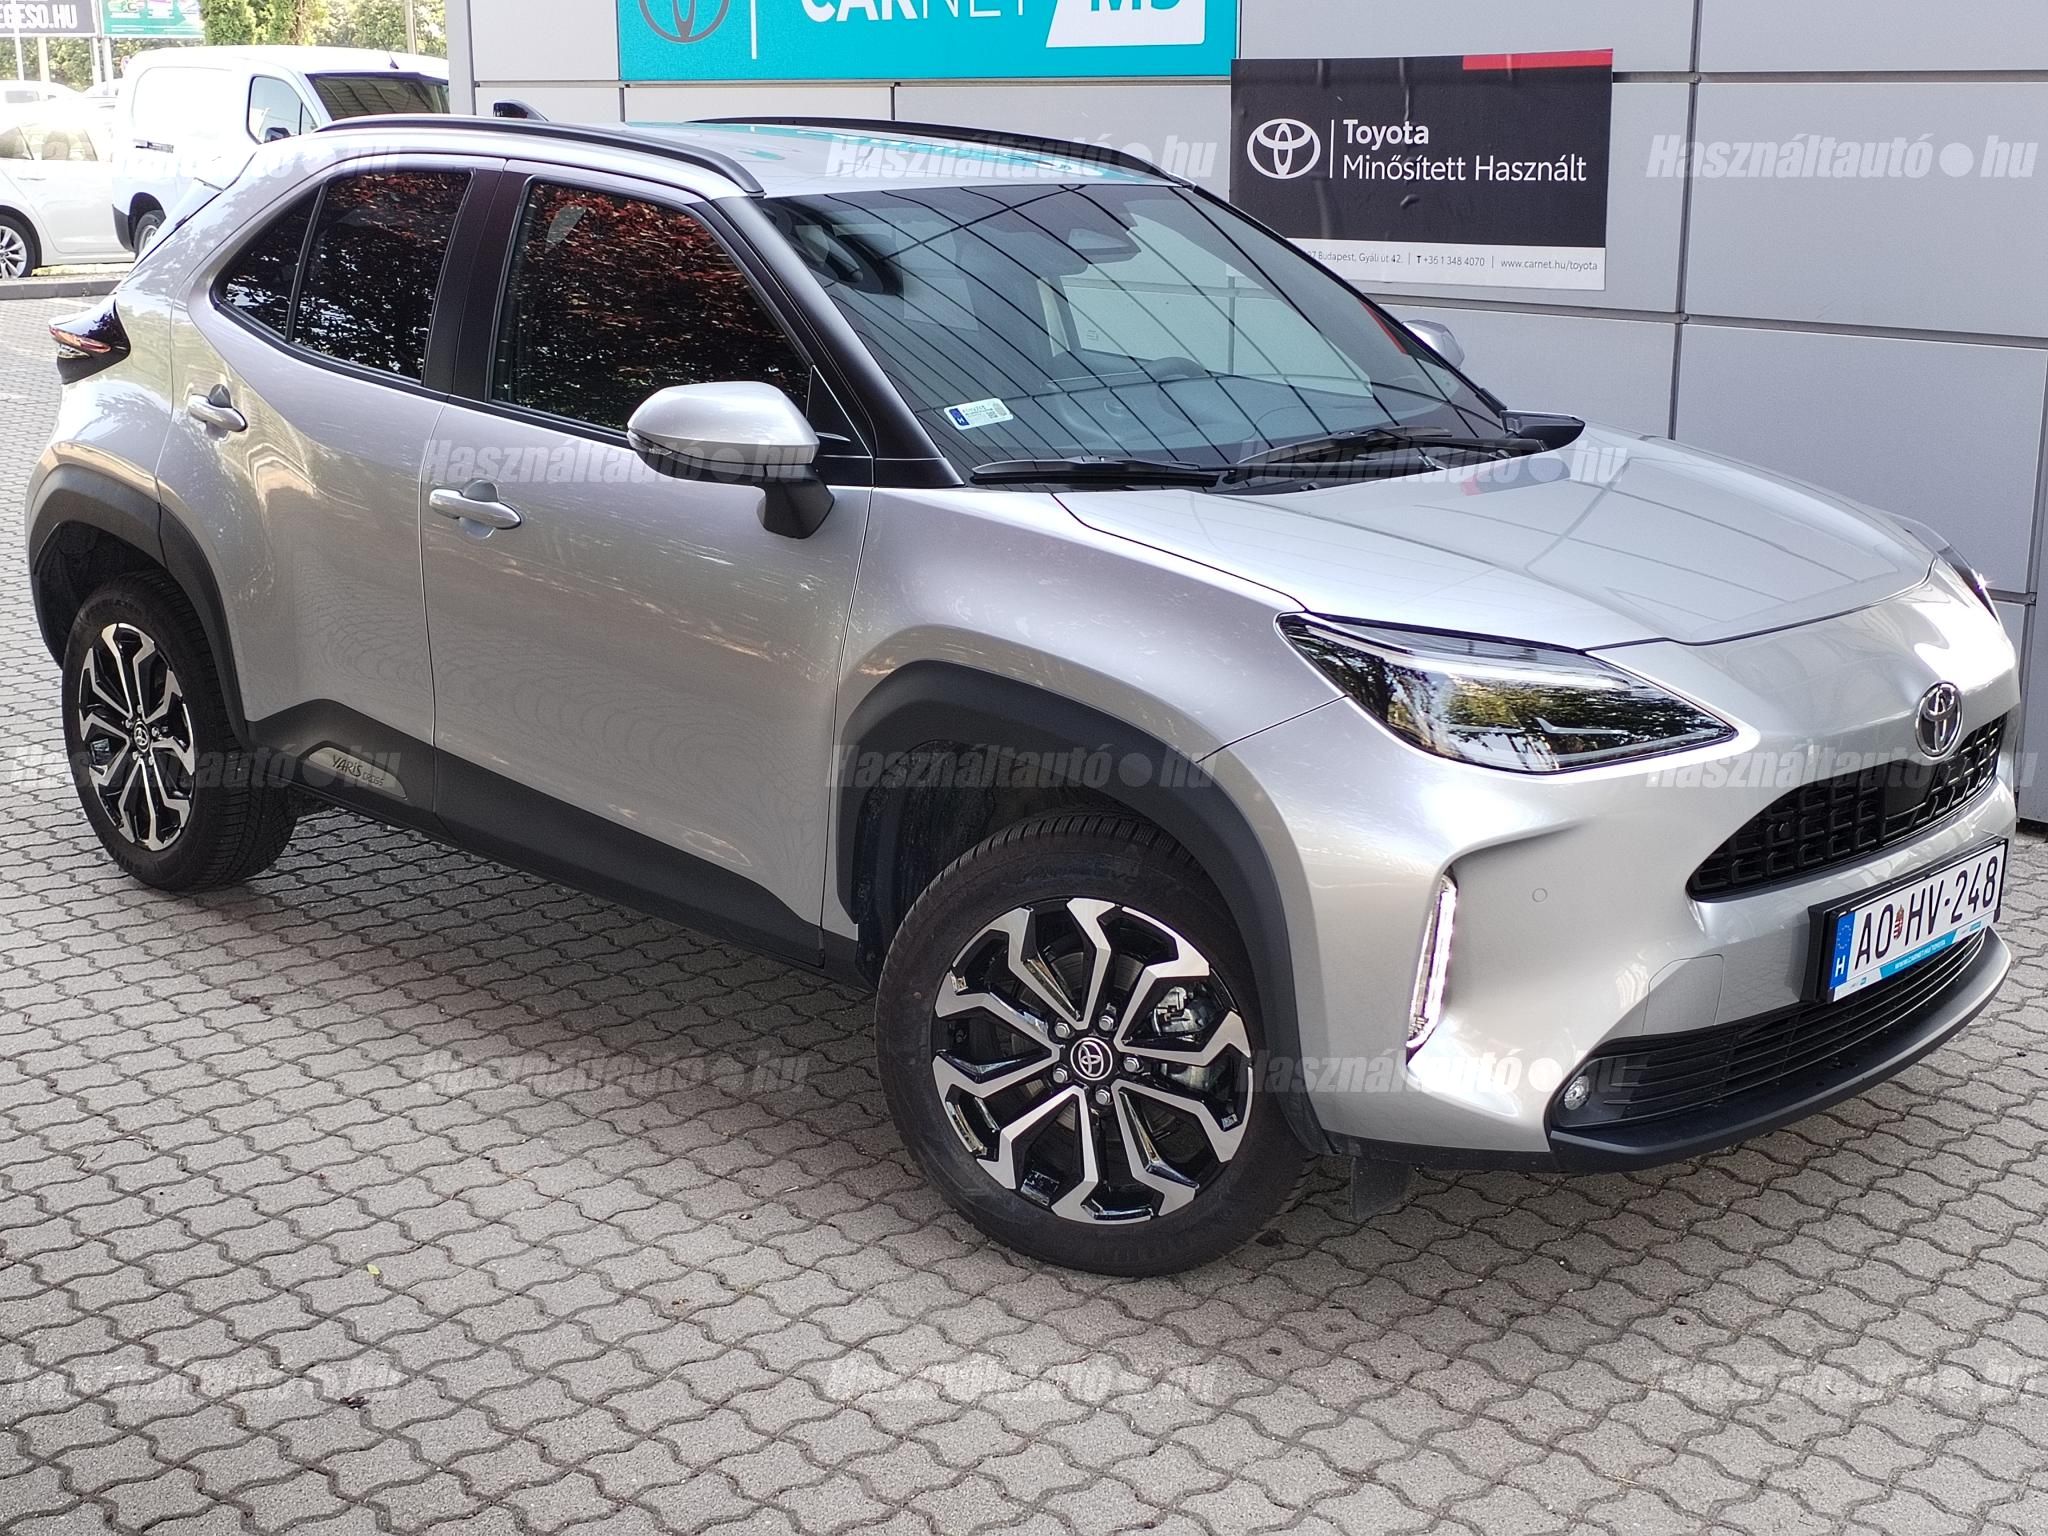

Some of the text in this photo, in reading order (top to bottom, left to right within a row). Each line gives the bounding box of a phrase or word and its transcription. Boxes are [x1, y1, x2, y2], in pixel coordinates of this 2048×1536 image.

[1343, 119, 1429, 150] Toyota
[1343, 154, 1587, 182] Minősített Használt
[1416, 255, 1422, 264] T
[1424, 255, 1439, 265] +36
[1446, 256, 1463, 266] 348
[1464, 257, 1485, 267] 4070
[1500, 259, 1598, 272] www.carnet.hu/toyota
[1854, 855, 1998, 970] AO HV-248
[1834, 955, 1847, 978] H
